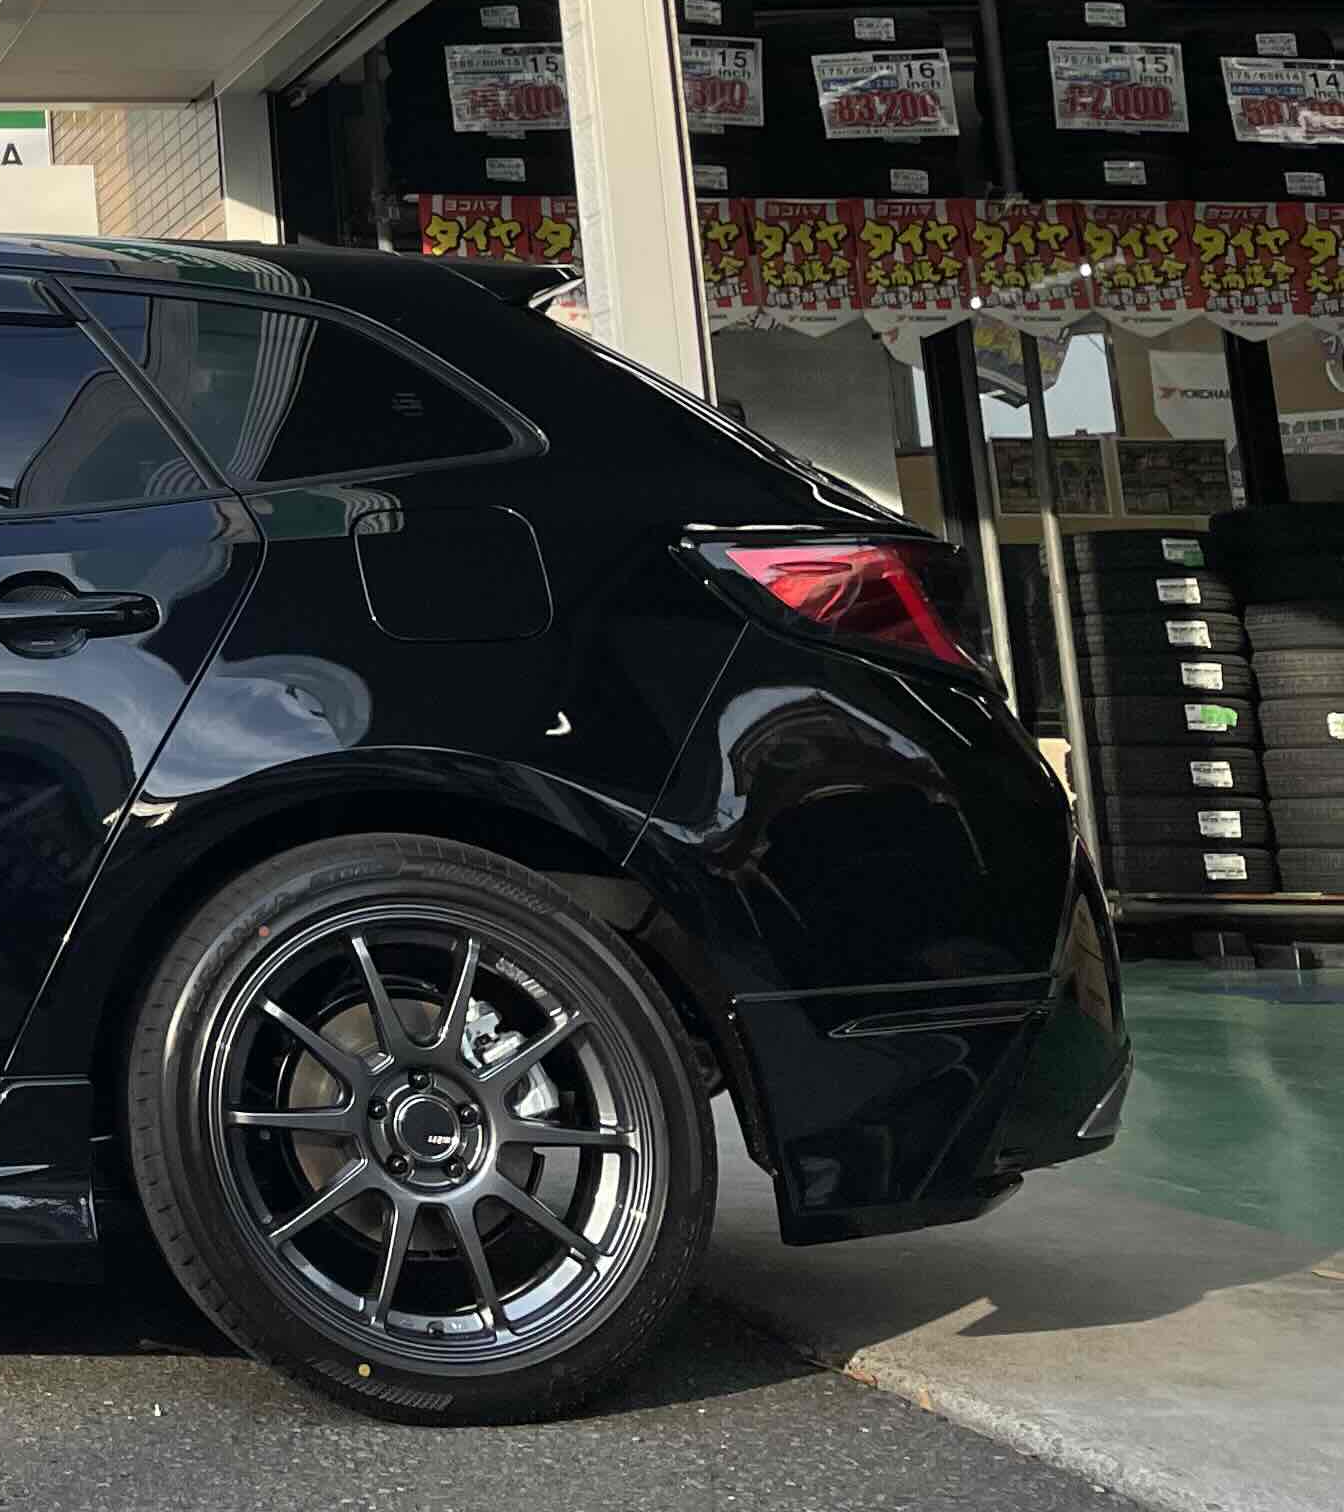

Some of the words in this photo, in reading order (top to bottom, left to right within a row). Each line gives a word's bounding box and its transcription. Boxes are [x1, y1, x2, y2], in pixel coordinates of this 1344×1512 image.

[529, 55, 559, 73] 15
[717, 49, 748, 68] 15
[903, 62, 936, 79] 16
[1136, 56, 1169, 73] 15
[1309, 73, 1339, 89] 14
[444, 199, 500, 213] ヨコハマ
[424, 215, 522, 257] タイヤ
[753, 219, 849, 259] タイヤ
[860, 219, 959, 259] タイヤ
[972, 220, 1069, 259] タイヤ
[1083, 222, 1179, 262] タイヤ
[1192, 223, 1290, 264] タイヤ
